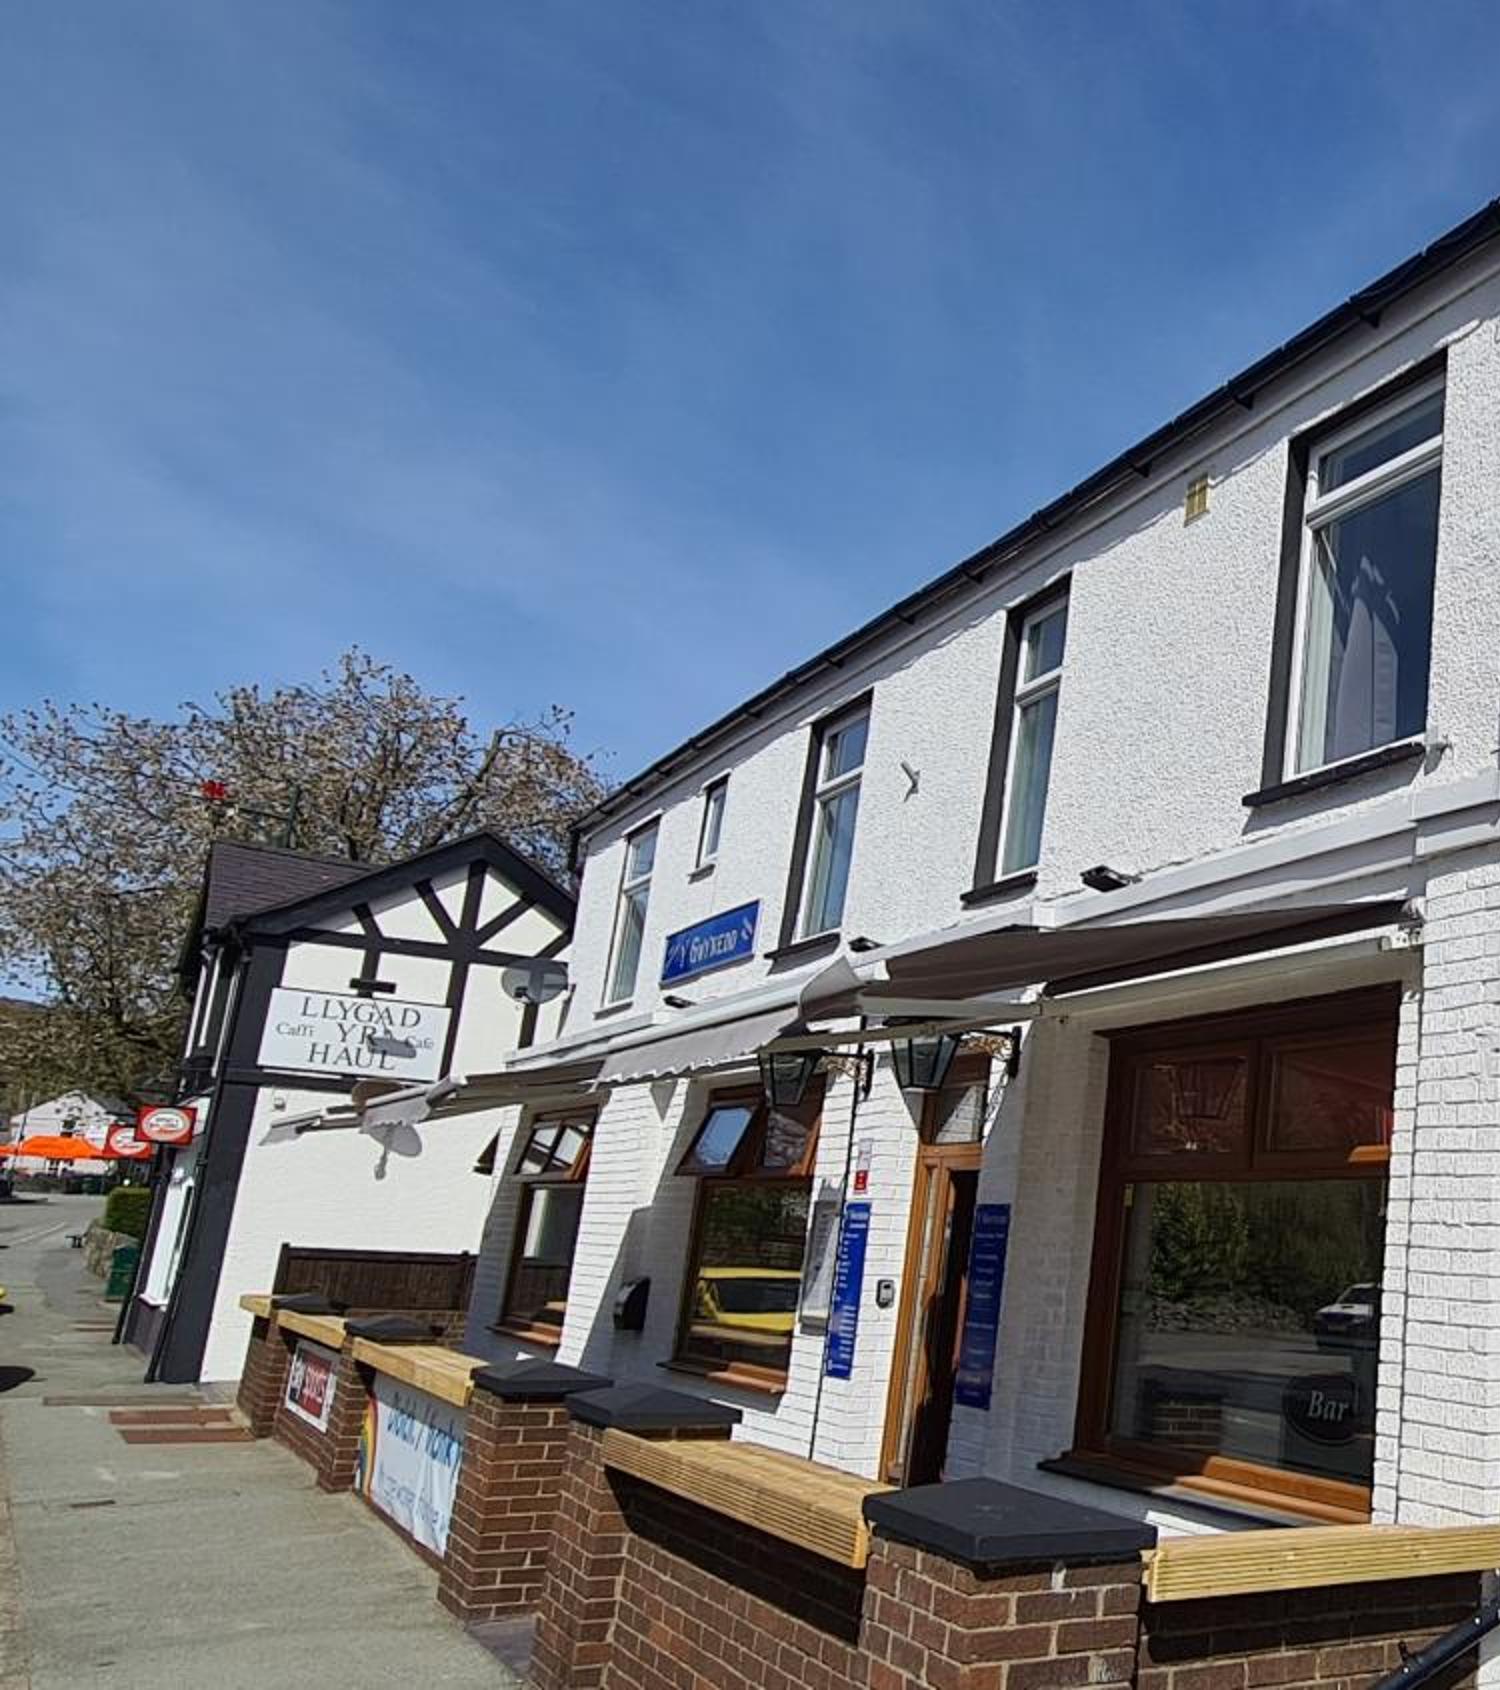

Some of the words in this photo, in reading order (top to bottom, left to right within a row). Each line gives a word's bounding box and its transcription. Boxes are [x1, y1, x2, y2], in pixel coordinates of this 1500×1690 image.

[301, 997, 421, 1028] LLYGAD
[307, 1043, 396, 1071] HAUL
[1308, 1390, 1349, 1421] Bar
